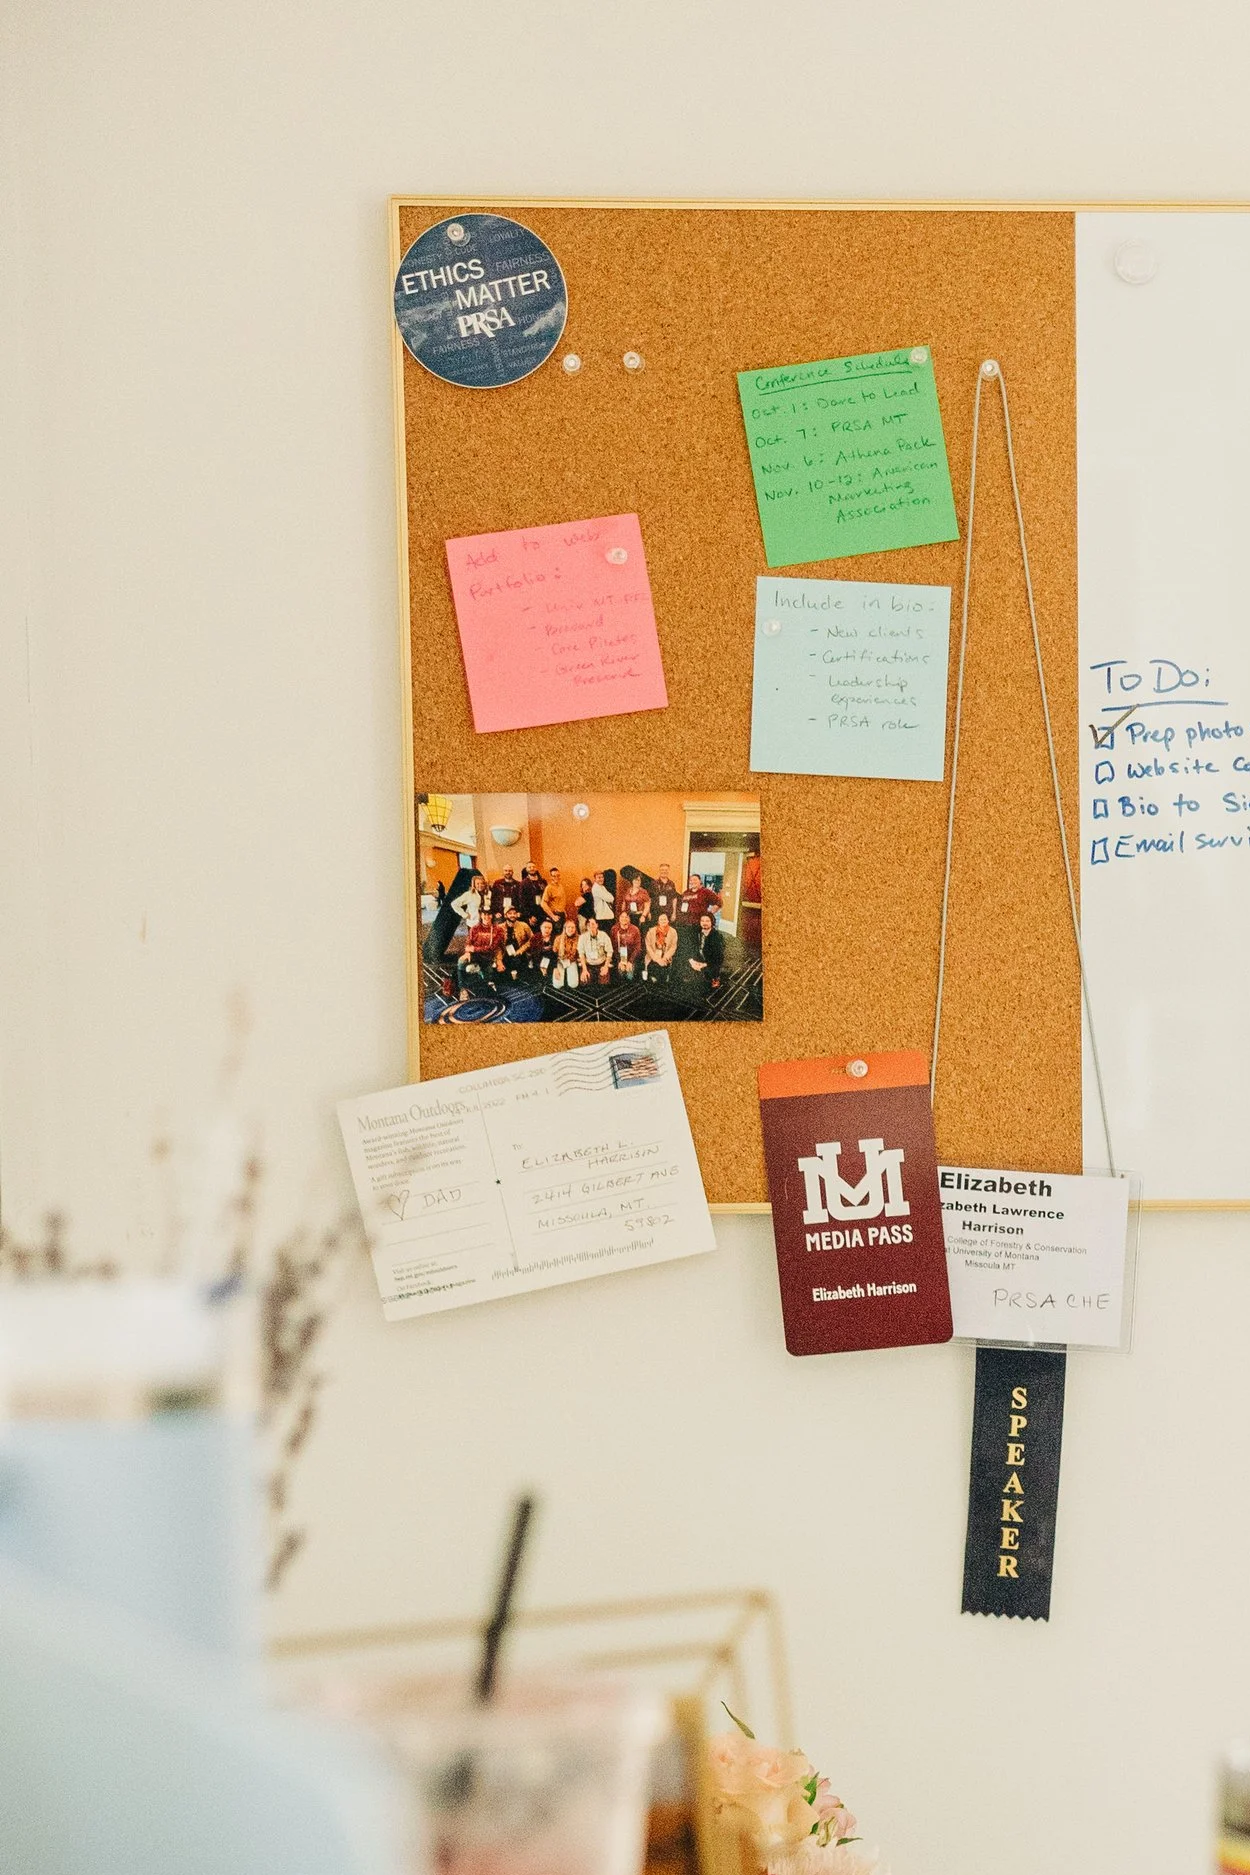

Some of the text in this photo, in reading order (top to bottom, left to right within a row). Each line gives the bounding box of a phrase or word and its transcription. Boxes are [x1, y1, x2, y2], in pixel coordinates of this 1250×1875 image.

[496, 251, 551, 273] FAIRNESS
[401, 258, 486, 296] ETHICS
[455, 269, 551, 311] MATTER
[457, 306, 517, 339] PRSA
[432, 338, 481, 356] FAIRNESS
[755, 355, 911, 391] Conference Schedule
[861, 391, 875, 402] to
[884, 382, 919, 399] Lead
[755, 436, 787, 449] Oct.
[831, 421, 872, 434] PRSA
[882, 413, 909, 426] MT
[835, 448, 892, 466] Athena
[765, 489, 799, 502] Nov.
[828, 481, 915, 505] Marketing
[836, 497, 931, 524] Association
[466, 549, 498, 569] Add
[522, 536, 540, 551] to
[774, 590, 935, 613] Include in bio:
[826, 625, 924, 640] New clients
[822, 649, 931, 665] Certifications
[1090, 659, 1211, 694] To Do:
[827, 713, 870, 729] PRSA
[1125, 721, 1177, 752] Prep
[1118, 795, 1159, 818] Bio
[1173, 793, 1200, 817] to
[1114, 830, 1185, 859] Email
[357, 1111, 410, 1133] Montana
[409, 1099, 466, 1122] Outdoors
[521, 1143, 609, 1170] ELIZABETH
[581, 1173, 645, 1195] GILBERT
[940, 1172, 1053, 1197] Elizabeth
[424, 1188, 462, 1208] DAD
[941, 1201, 1065, 1220] zabeth Lawrence
[805, 1224, 914, 1252] MEDIA PASS
[962, 1220, 1025, 1236] Harrison
[947, 1235, 978, 1247] College
[980, 1238, 988, 1247] of
[990, 1239, 1024, 1252] Forestry
[1034, 1243, 1088, 1255] Conservation
[953, 1246, 993, 1259] University
[994, 1250, 1003, 1258] of
[1004, 1252, 1040, 1262] Montana
[964, 1259, 1016, 1271] Missoula MT
[812, 1280, 917, 1302] Elizabeth Harrison
[993, 1288, 1057, 1310] PRSA
[996, 1386, 1029, 1579] SPEAKER
